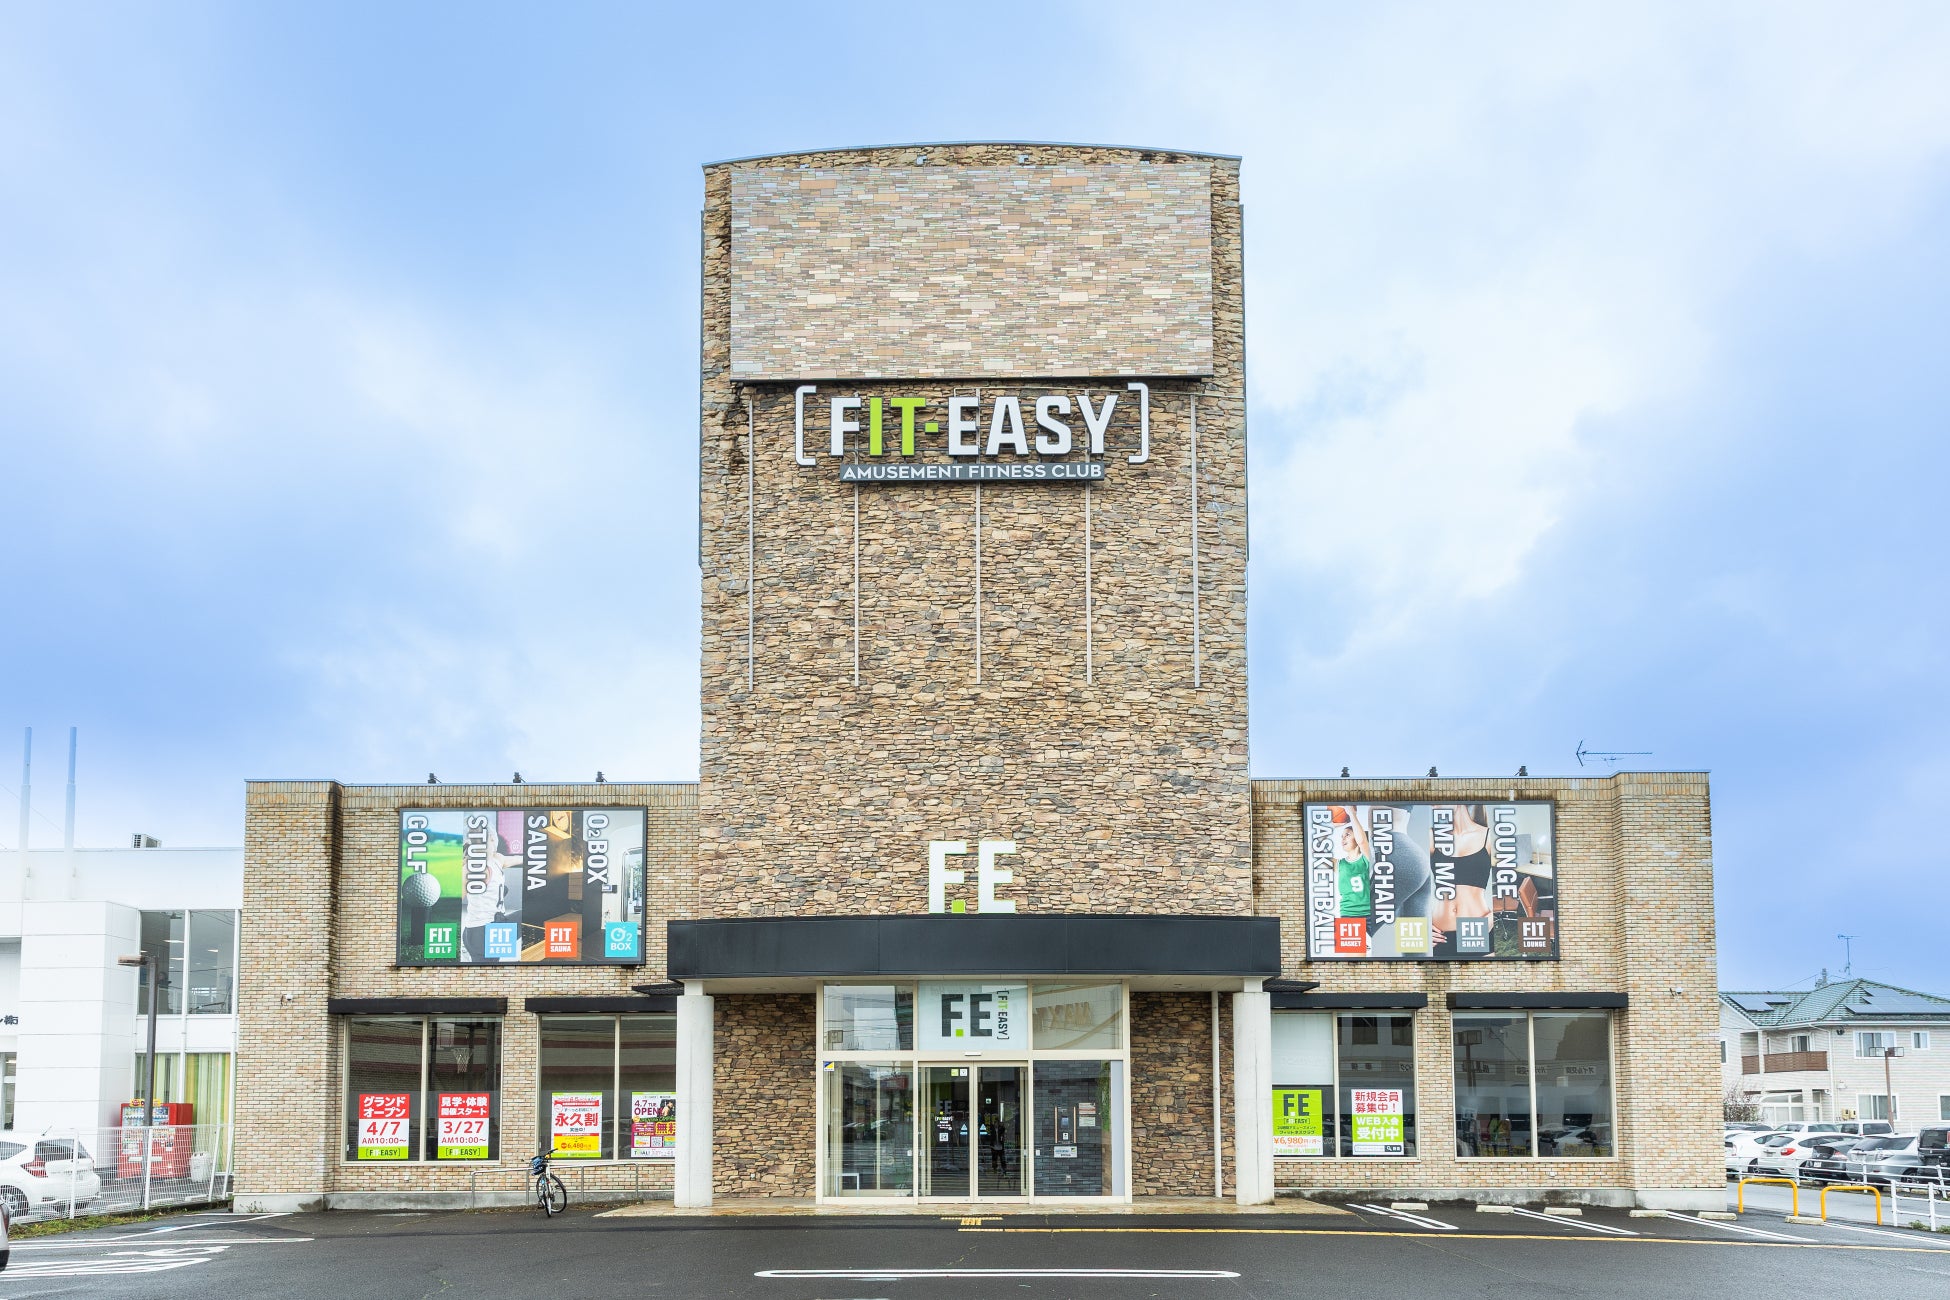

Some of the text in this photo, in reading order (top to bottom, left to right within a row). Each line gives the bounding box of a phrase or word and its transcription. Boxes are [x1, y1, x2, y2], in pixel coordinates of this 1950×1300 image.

[842, 464, 1102, 480] AMUSEMENT FITNESS CLUB
[406, 815, 429, 874] GOLF
[466, 815, 488, 895] STUDIO
[527, 815, 548, 891] SAUNA
[1433, 809, 1456, 901] EMP M/C
[1494, 808, 1518, 899] LOUNGE
[1372, 809, 1396, 924] EMP-CHAIR
[1311, 809, 1335, 953] BASKETBALL
[1350, 876, 1364, 892] 9
[429, 928, 452, 942] FIT
[489, 928, 512, 942] FIT
[550, 928, 572, 942] FIT
[1340, 923, 1361, 937] FIT
[1400, 922, 1423, 937] FIT
[1461, 922, 1484, 936] FIT
[1522, 922, 1546, 936] FIT
[364, 1096, 406, 1107] グランド
[1355, 1091, 1399, 1102] 新規会員
[363, 1107, 406, 1118] オープン
[555, 1112, 599, 1127] 永久割
[366, 1121, 401, 1136] 4/7
[443, 1120, 484, 1134] 3/27
[1357, 1127, 1399, 1140] 受付中
